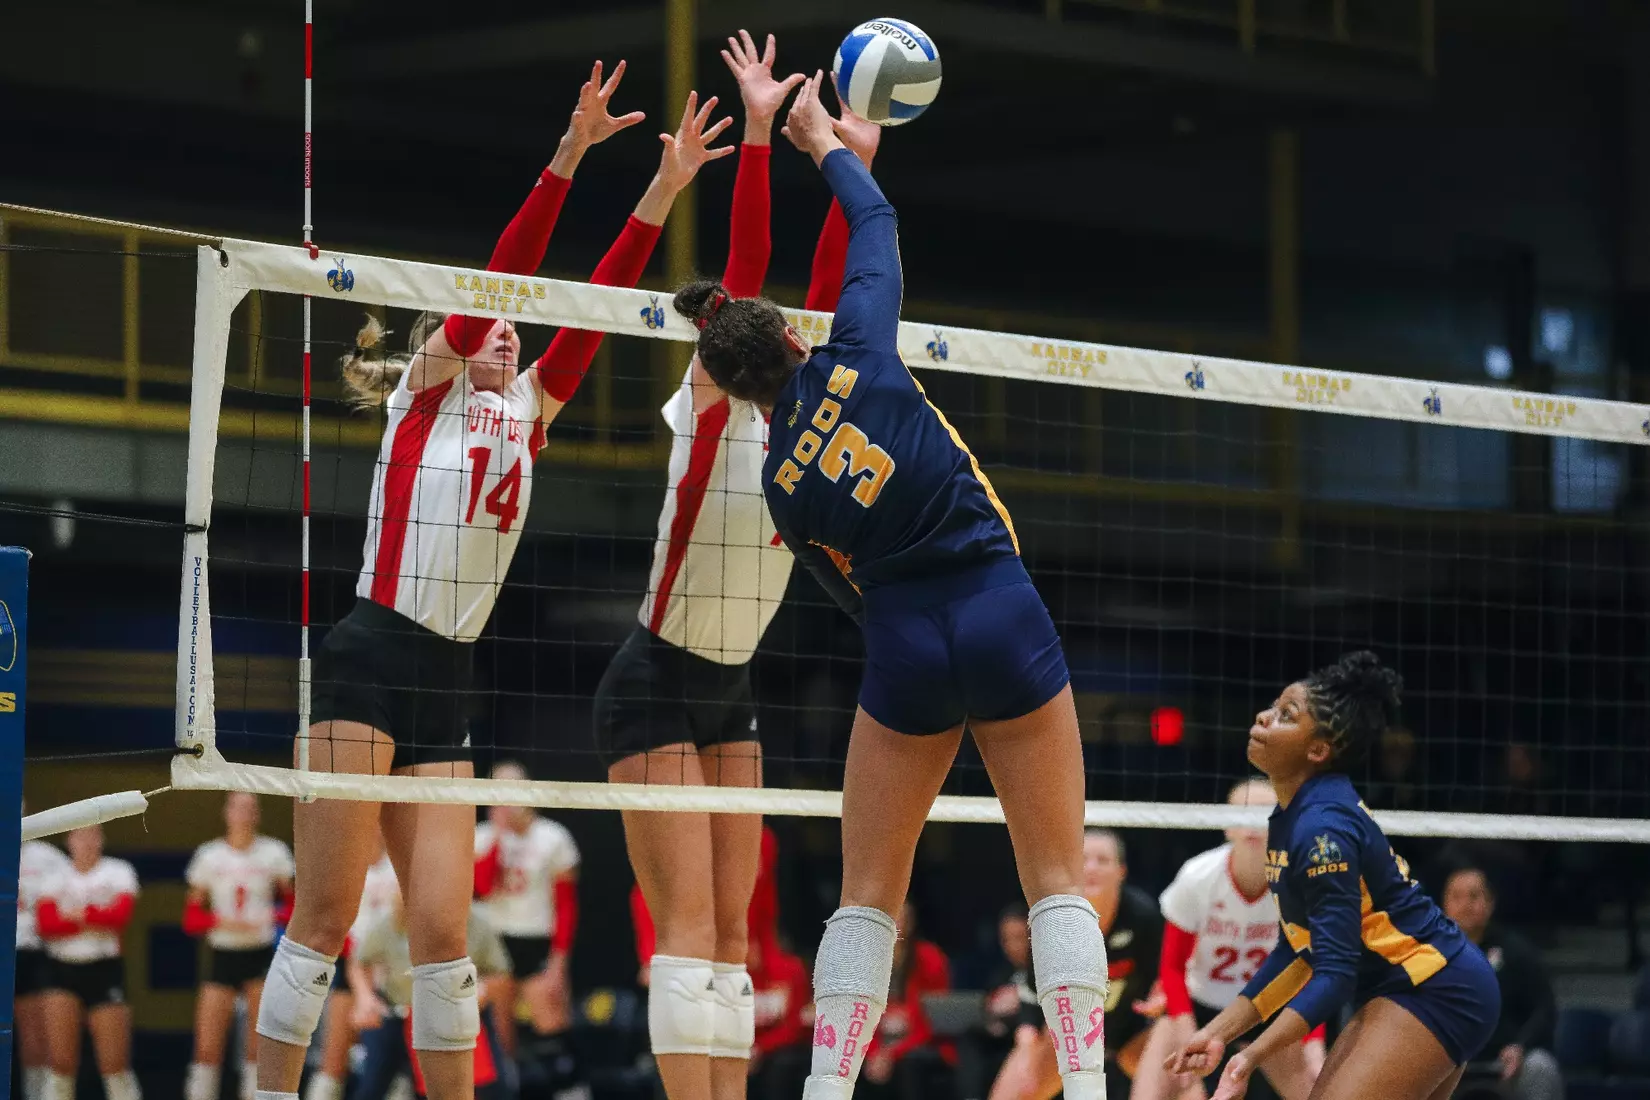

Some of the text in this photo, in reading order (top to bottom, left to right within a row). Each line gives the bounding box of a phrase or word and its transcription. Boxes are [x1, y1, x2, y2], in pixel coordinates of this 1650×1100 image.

[864, 22, 917, 50] molten
[454, 273, 546, 299] KANSAS
[473, 293, 526, 313] CITY
[1031, 343, 1107, 365] KANSAS
[1047, 361, 1092, 377] CITY
[773, 364, 859, 496] ROOS
[818, 422, 896, 508] 3
[465, 446, 523, 534] 14
[1306, 861, 1349, 878] ROOS
[837, 1002, 869, 1078] ROOS
[1055, 997, 1081, 1072] ROOS
